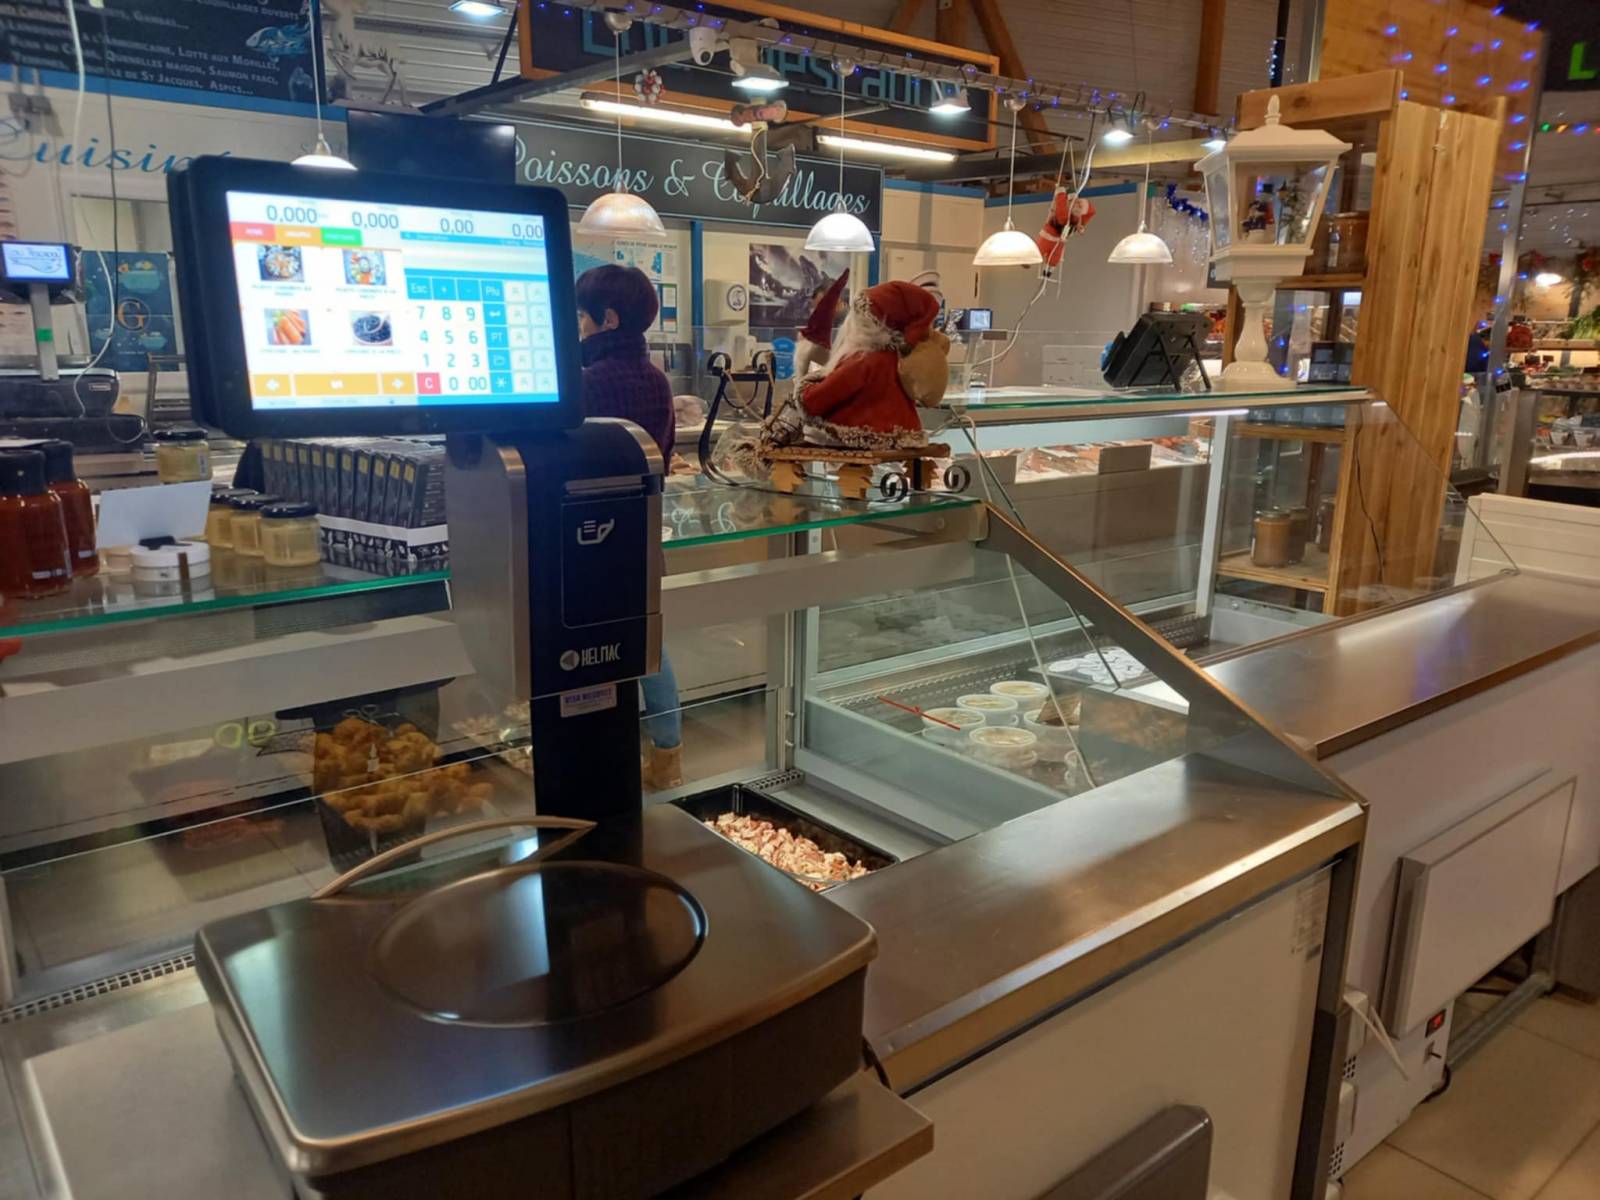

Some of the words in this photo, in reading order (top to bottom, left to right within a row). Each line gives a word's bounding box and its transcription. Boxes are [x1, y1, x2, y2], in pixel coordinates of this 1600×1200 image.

[117, 299, 146, 331] G
[416, 305, 426, 320] 7
[442, 306, 453, 322] 8
[465, 307, 476, 322] 9
[419, 329, 430, 344] 4
[444, 329, 454, 345] 5
[468, 330, 479, 345] 6
[423, 353, 430, 368] 1
[447, 353, 456, 368] 2
[472, 353, 481, 368] 3
[449, 376, 459, 391] 0
[468, 376, 488, 391] 00
[581, 642, 622, 667] HELMAC
